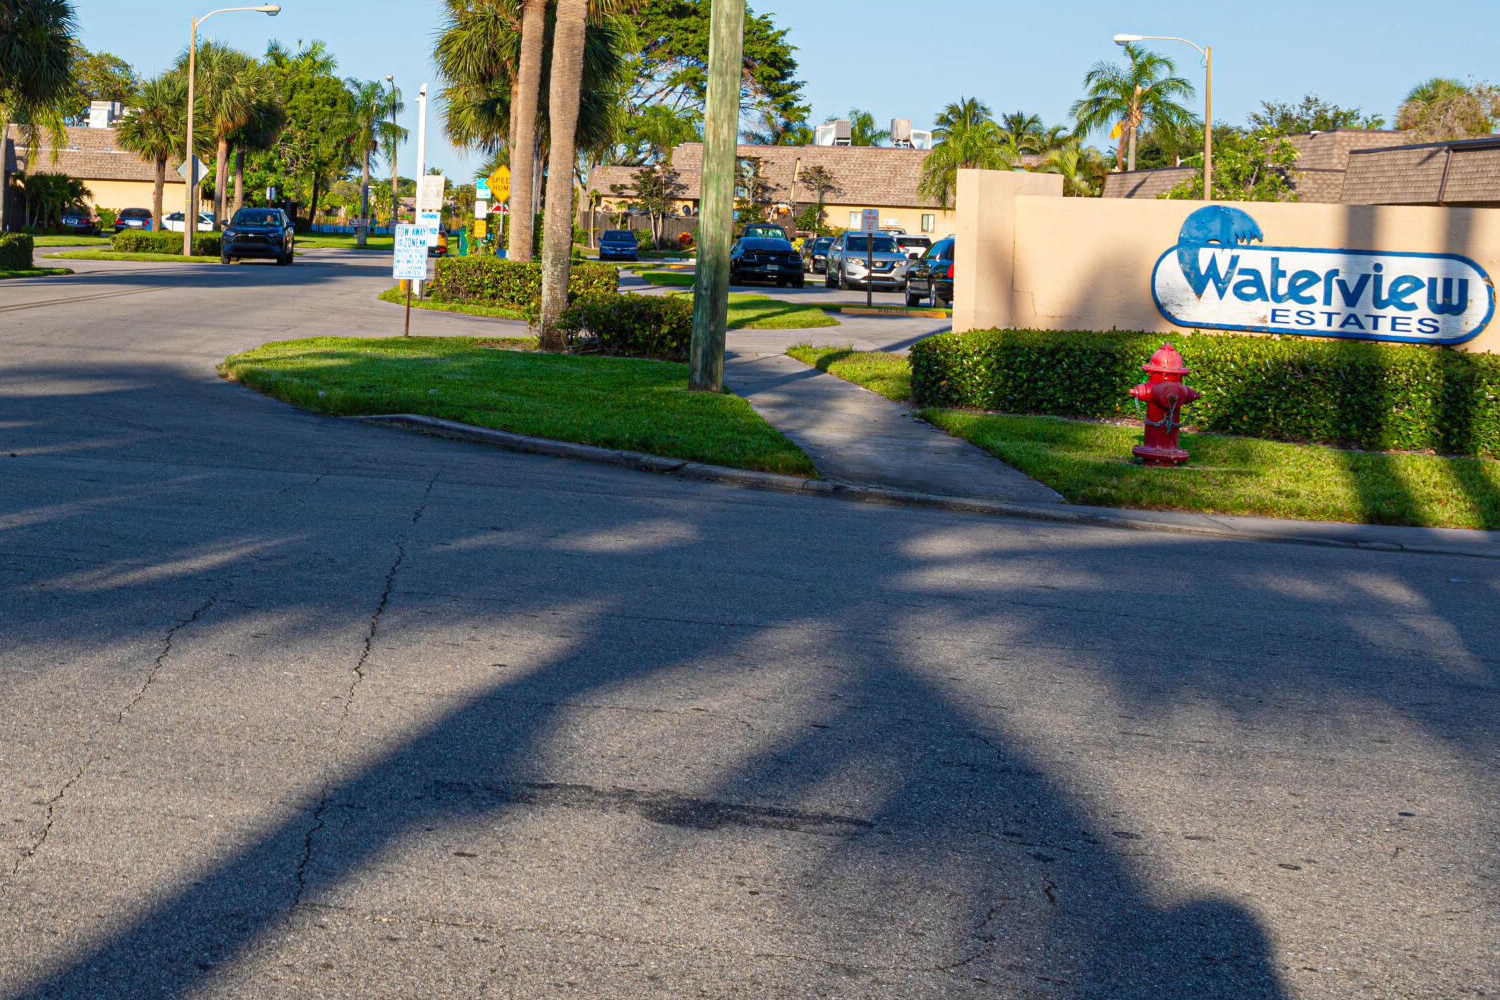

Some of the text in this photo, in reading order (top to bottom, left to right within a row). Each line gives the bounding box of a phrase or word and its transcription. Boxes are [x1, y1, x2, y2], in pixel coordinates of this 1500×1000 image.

[397, 226, 409, 237] TOW
[412, 227, 426, 237] AWAY
[404, 237, 419, 248] ZONE
[1177, 246, 1469, 316] Waterview
[1270, 308, 1441, 334] ESTATES
